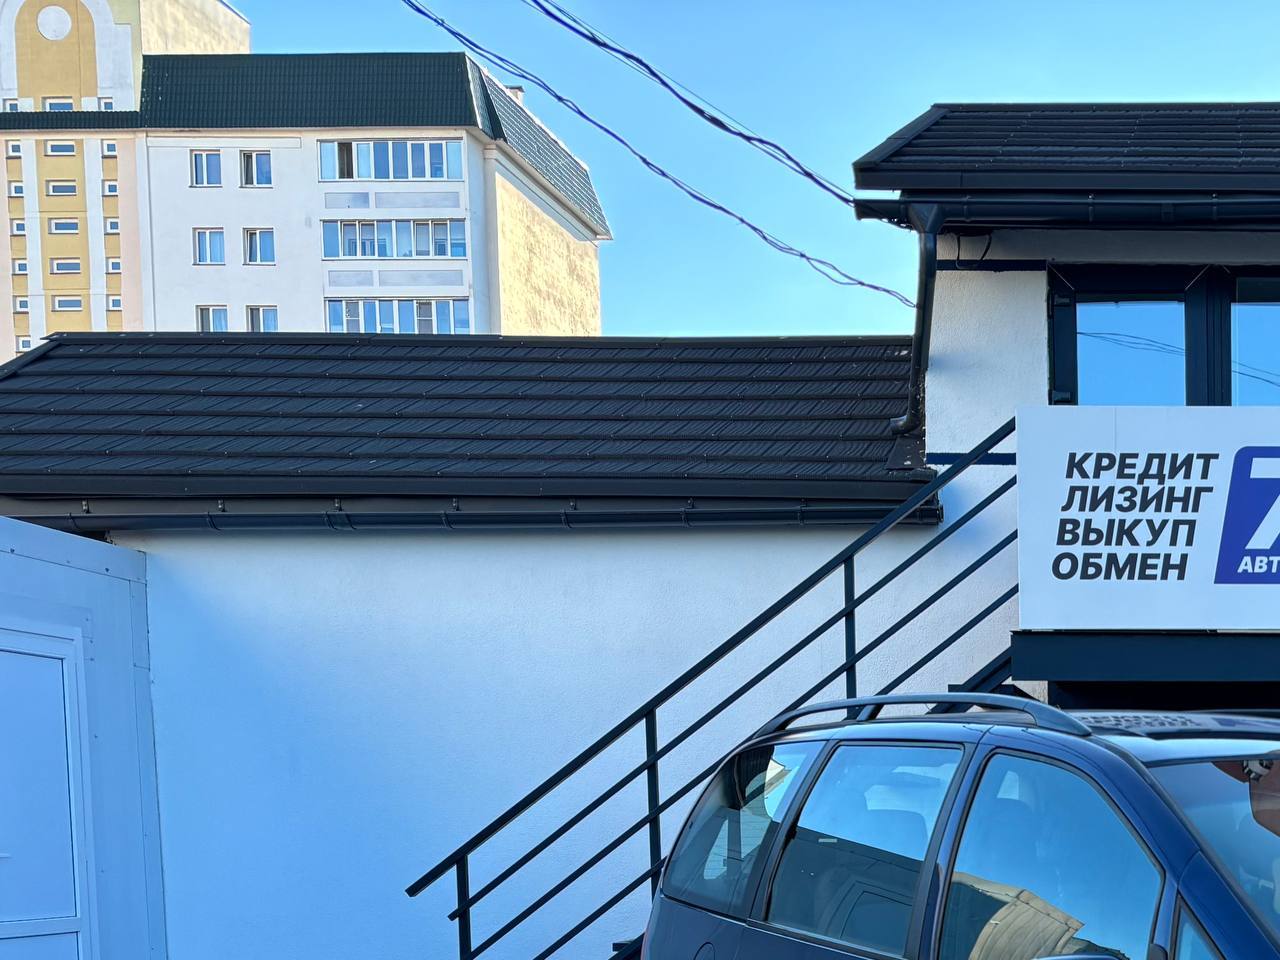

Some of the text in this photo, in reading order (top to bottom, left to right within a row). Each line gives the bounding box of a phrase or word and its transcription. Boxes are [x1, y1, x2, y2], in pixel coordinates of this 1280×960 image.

[1065, 452, 1219, 484] КРЕДИТ
[1061, 485, 1213, 513] ЛИЗИНГ
[1056, 518, 1197, 547] ВЫКУП
[1051, 552, 1188, 581] ОБМЕН
